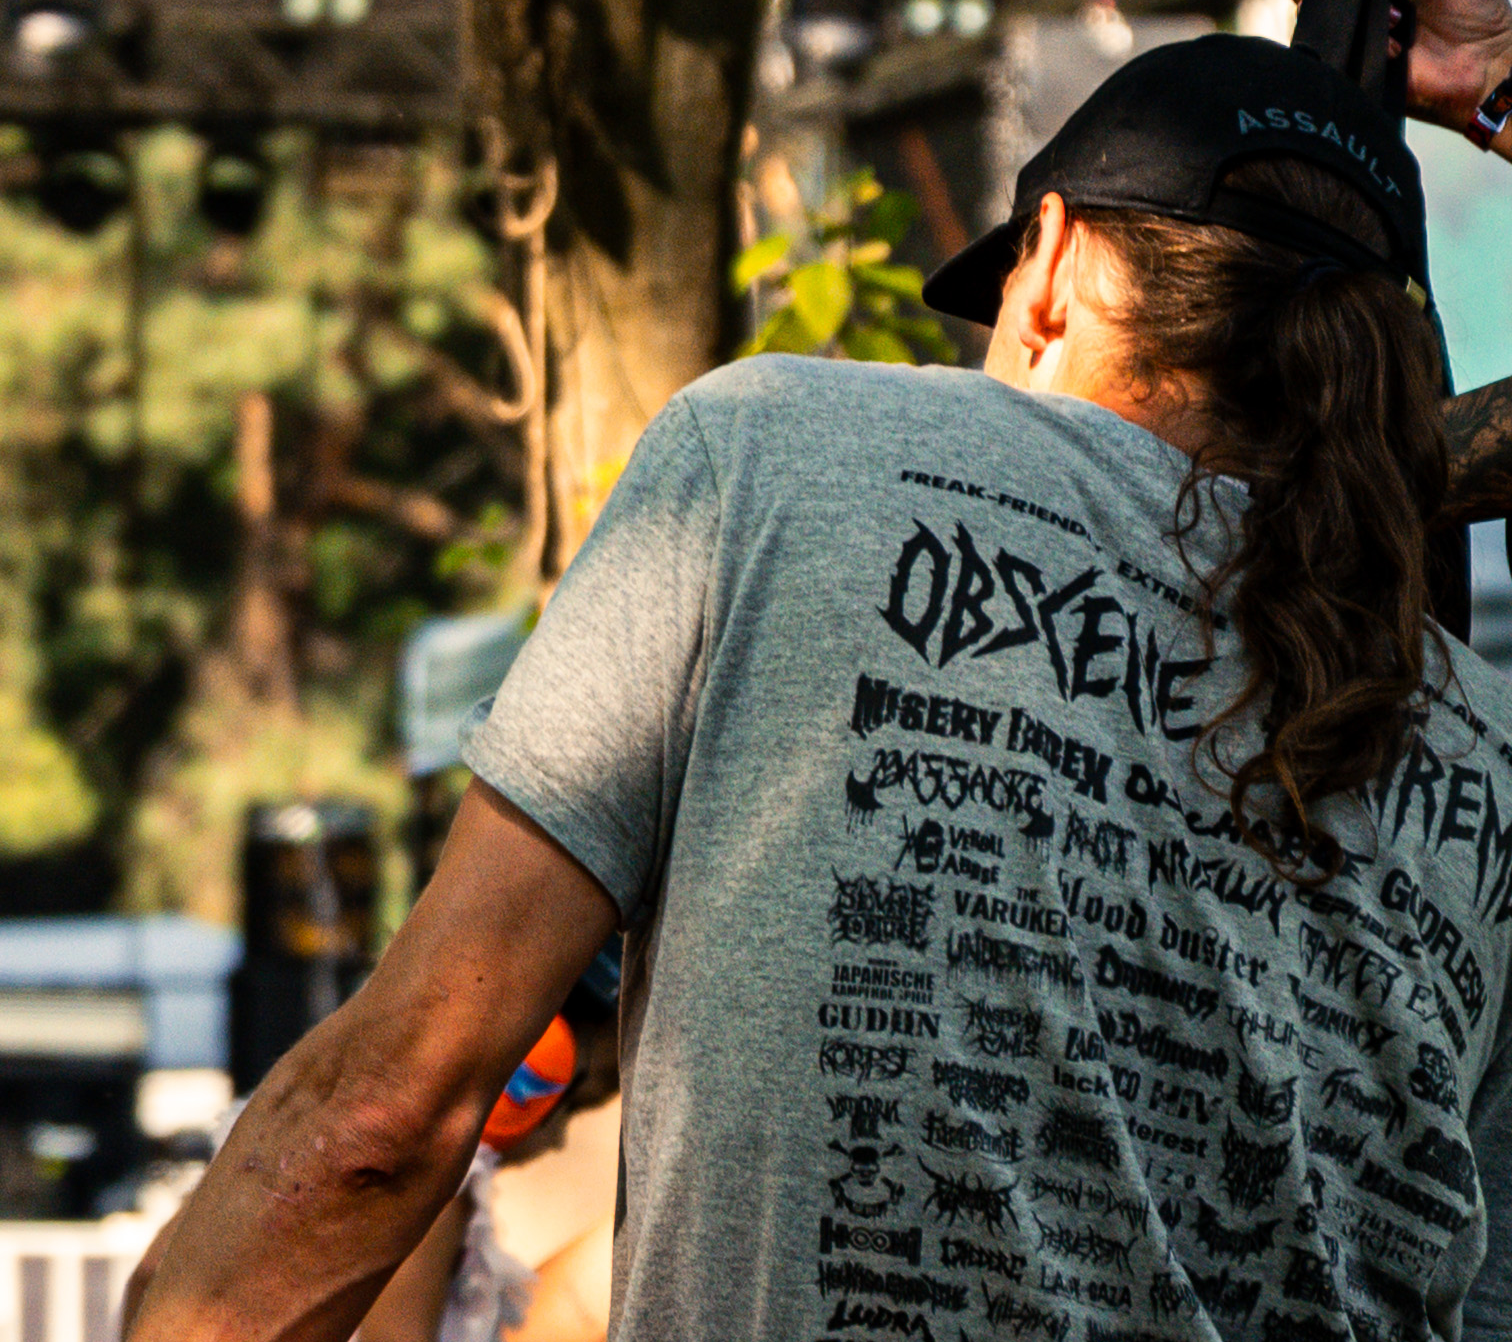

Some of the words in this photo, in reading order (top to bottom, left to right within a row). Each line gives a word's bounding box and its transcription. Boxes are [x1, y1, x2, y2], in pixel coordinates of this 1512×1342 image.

[1236, 107, 1403, 200] ASSAULT
[875, 517, 1220, 741] OBSCENE
[847, 672, 1003, 745] MISERY
[832, 963, 936, 991] JAPANISCHE
[1053, 1064, 1109, 1098] lack
[1127, 1115, 1209, 1157] terest
